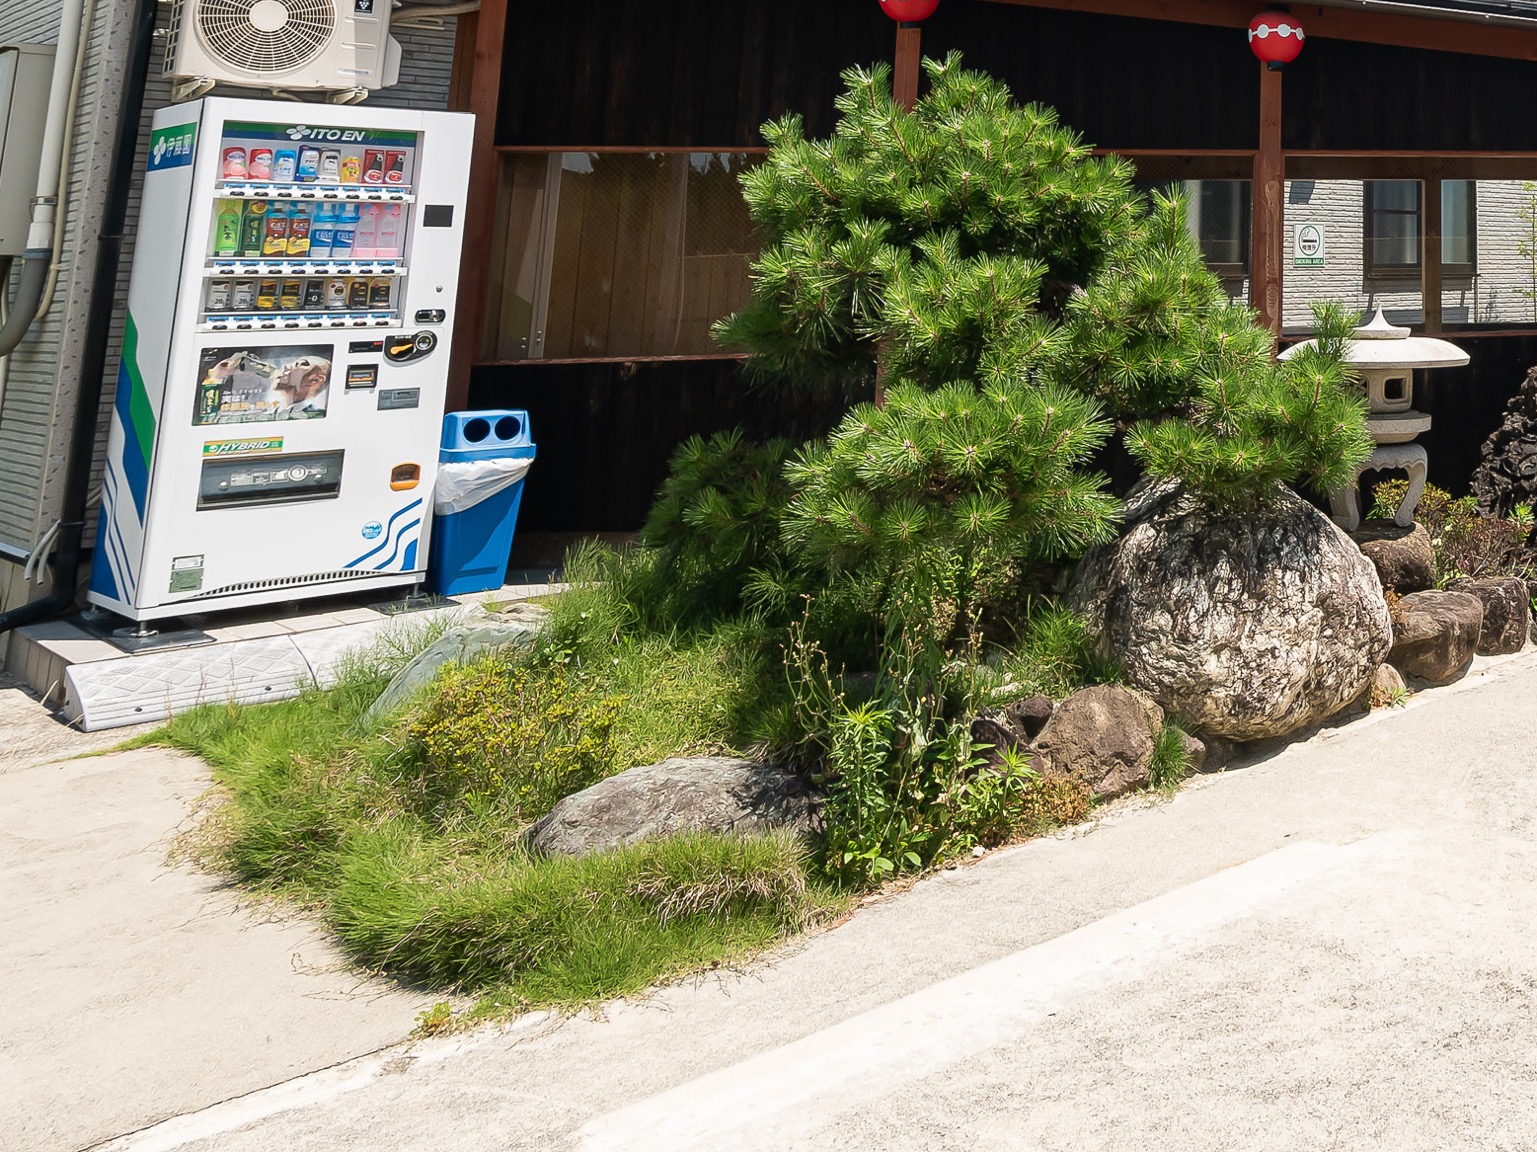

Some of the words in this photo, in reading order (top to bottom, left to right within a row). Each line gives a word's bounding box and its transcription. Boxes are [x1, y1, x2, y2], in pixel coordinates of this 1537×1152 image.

[309, 128, 341, 140] ITO
[341, 129, 365, 142] EN
[166, 133, 192, 158] 伊藤園
[217, 441, 271, 453] HYBRID
